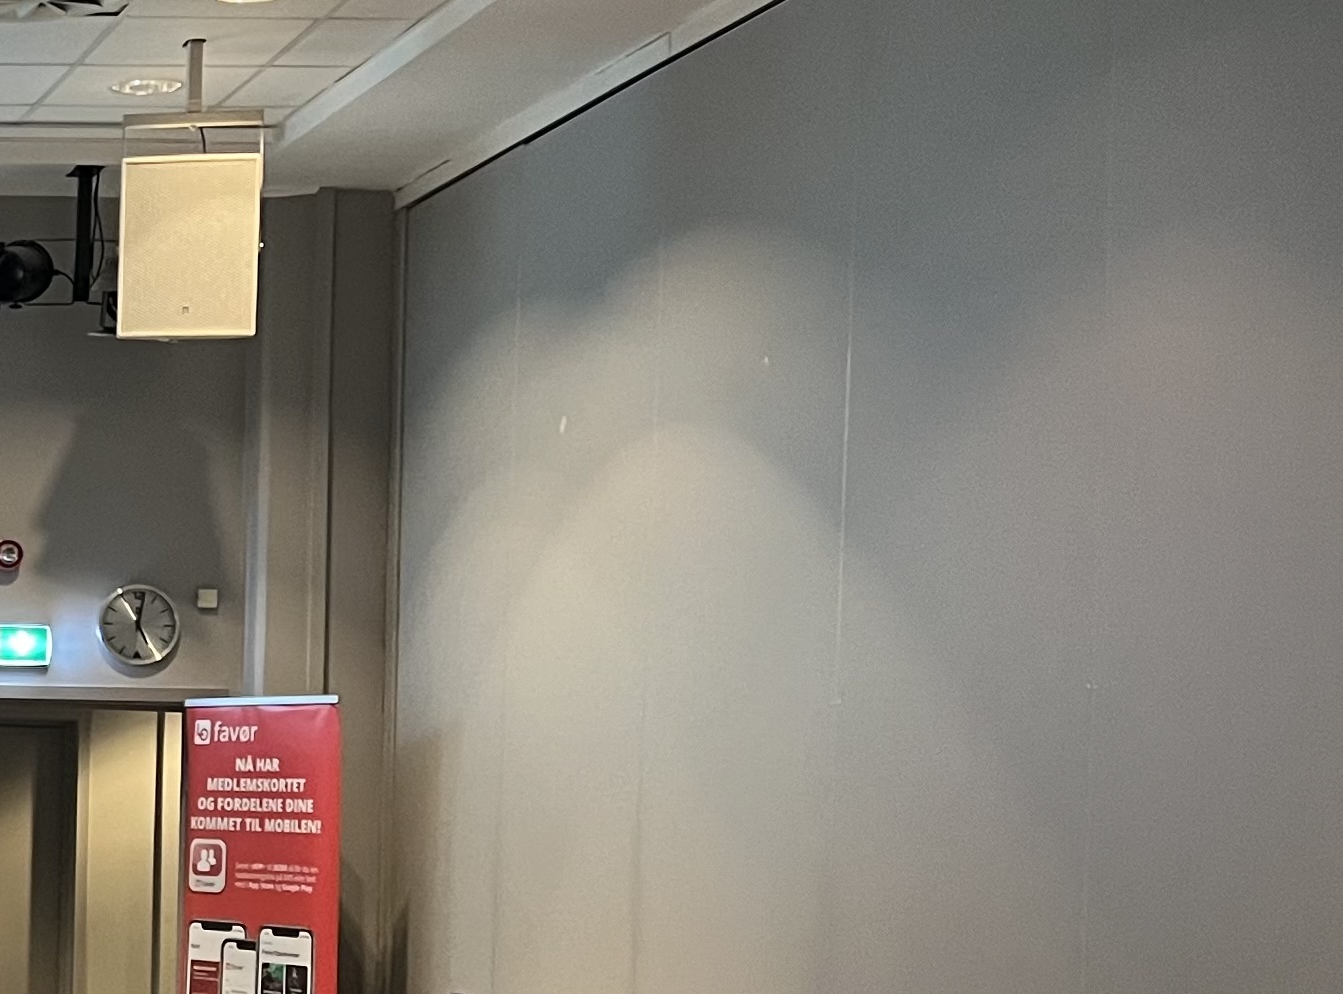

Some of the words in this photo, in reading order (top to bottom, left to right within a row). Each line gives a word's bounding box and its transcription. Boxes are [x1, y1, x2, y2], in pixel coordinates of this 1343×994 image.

[214, 720, 258, 743] favør
[235, 755, 254, 772] NÅ
[256, 758, 280, 772] HAR
[207, 777, 306, 793] MEDLEMSKORTET
[198, 797, 214, 811] OG
[217, 798, 283, 813] FORDELENE
[285, 799, 314, 814] DINE
[191, 816, 242, 830] KOMMET
[245, 818, 262, 832] TIL
[264, 818, 321, 834] MOBILEN!
